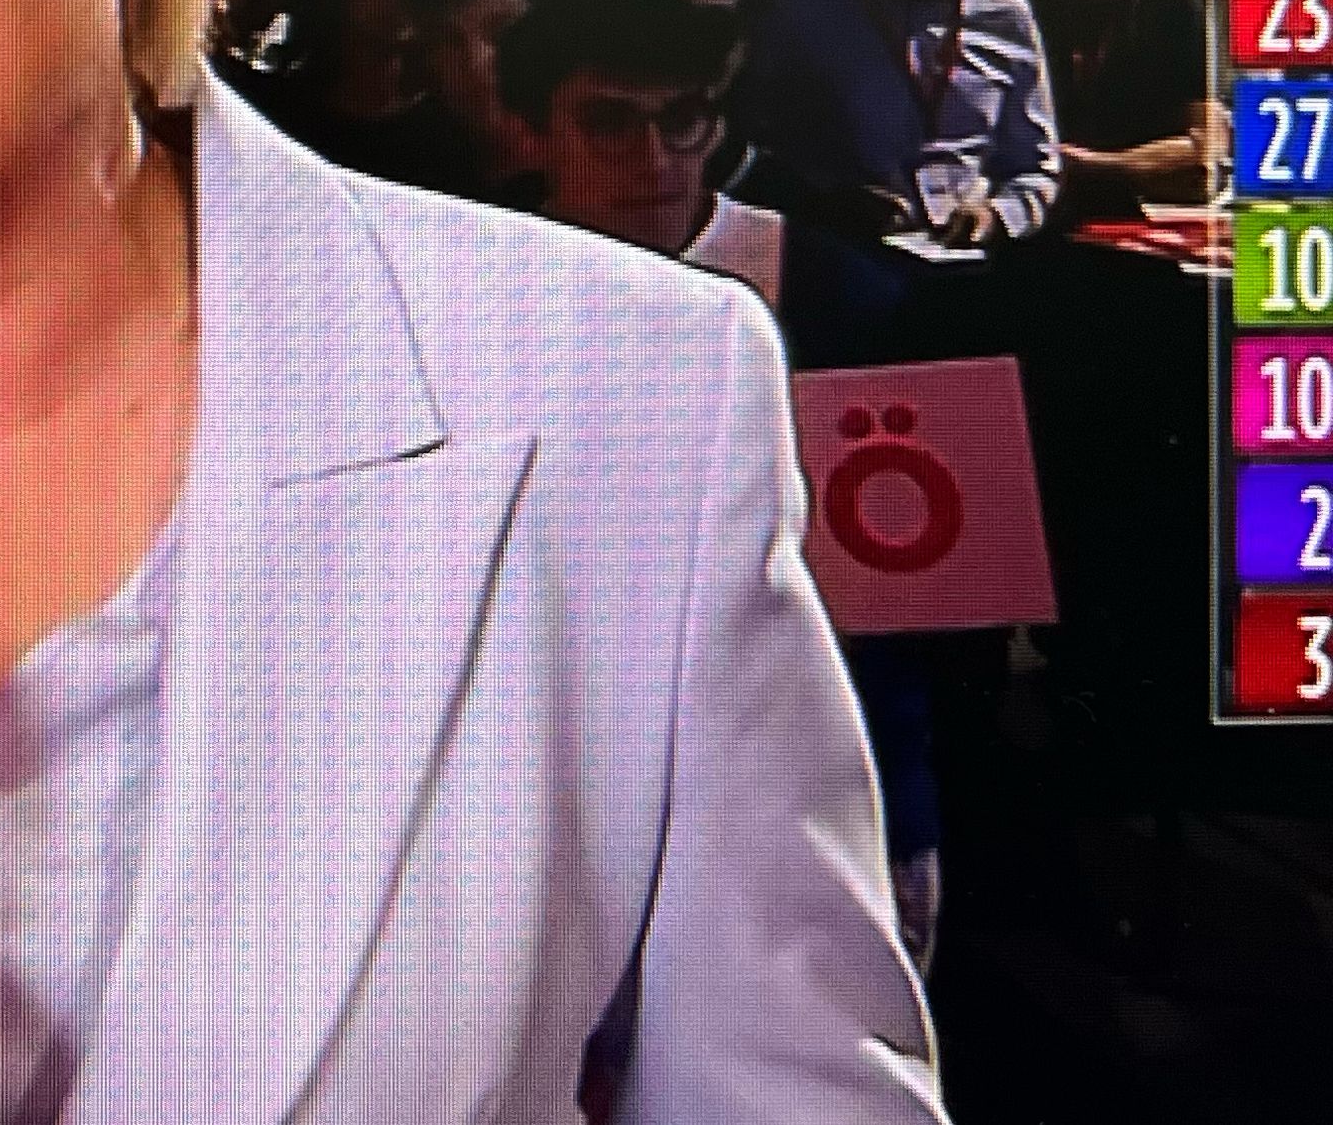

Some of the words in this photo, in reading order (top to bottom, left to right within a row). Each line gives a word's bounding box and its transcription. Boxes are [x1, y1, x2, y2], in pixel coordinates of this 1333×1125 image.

[1258, 97, 1332, 183] 27
[1258, 225, 1333, 312] 10
[1259, 356, 1333, 441] 10
[825, 399, 965, 574] Ö
[1299, 485, 1333, 571] 2
[1296, 614, 1333, 700] 3
